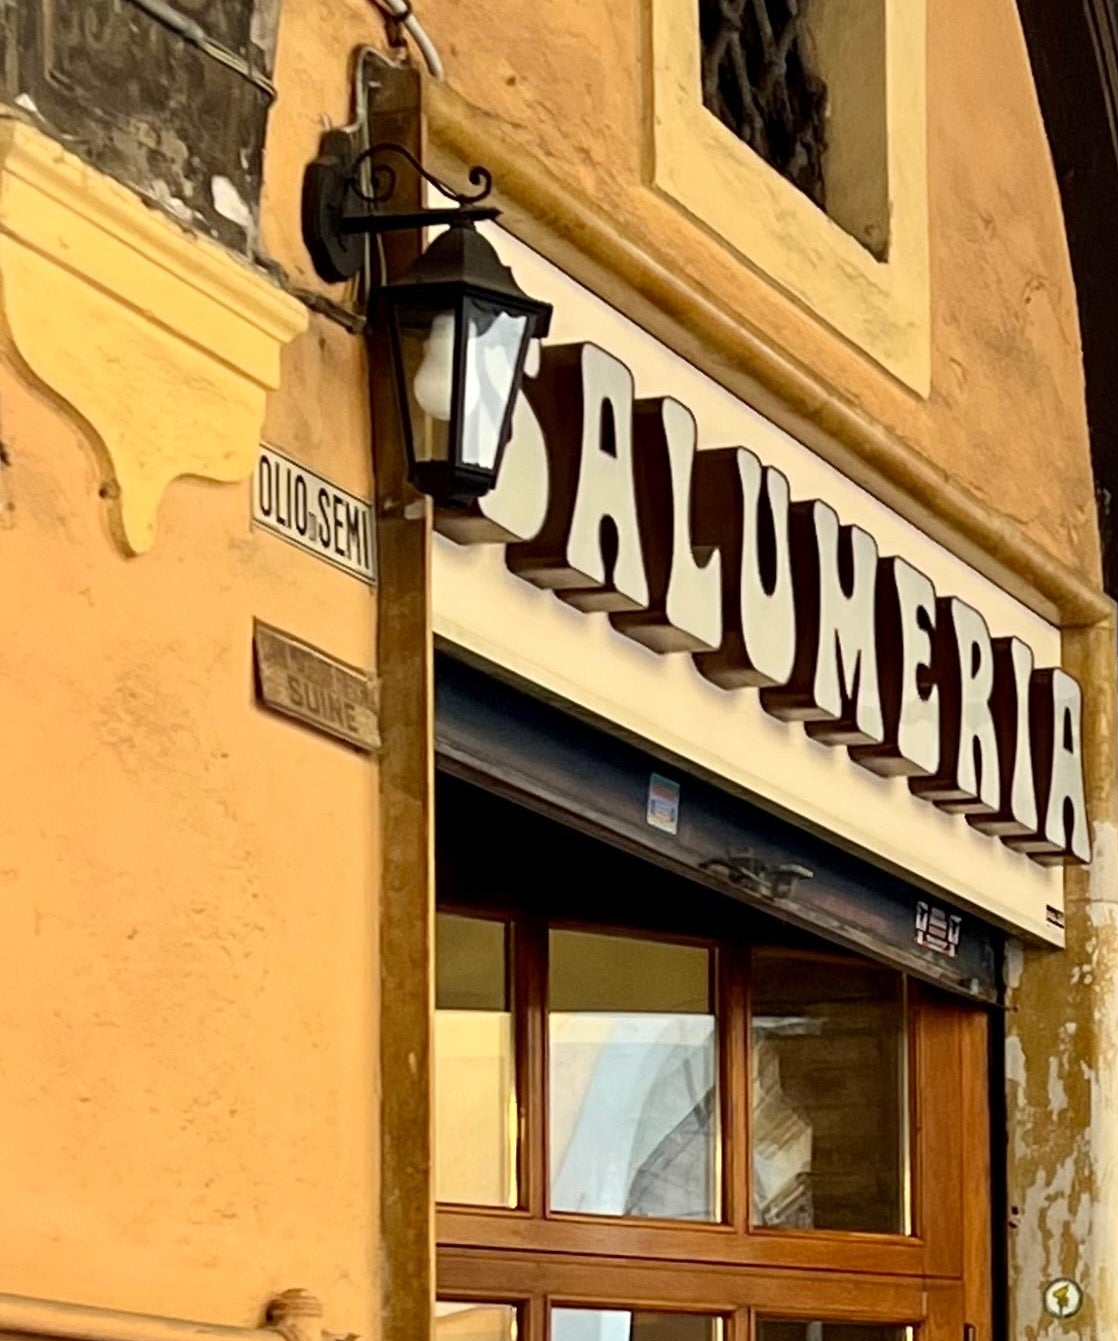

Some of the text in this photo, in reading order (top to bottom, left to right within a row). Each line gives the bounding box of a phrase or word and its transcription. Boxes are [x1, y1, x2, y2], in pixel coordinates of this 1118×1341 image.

[259, 454, 307, 536] OLIO
[318, 487, 370, 570] SEMI
[287, 672, 359, 733] SUINE
